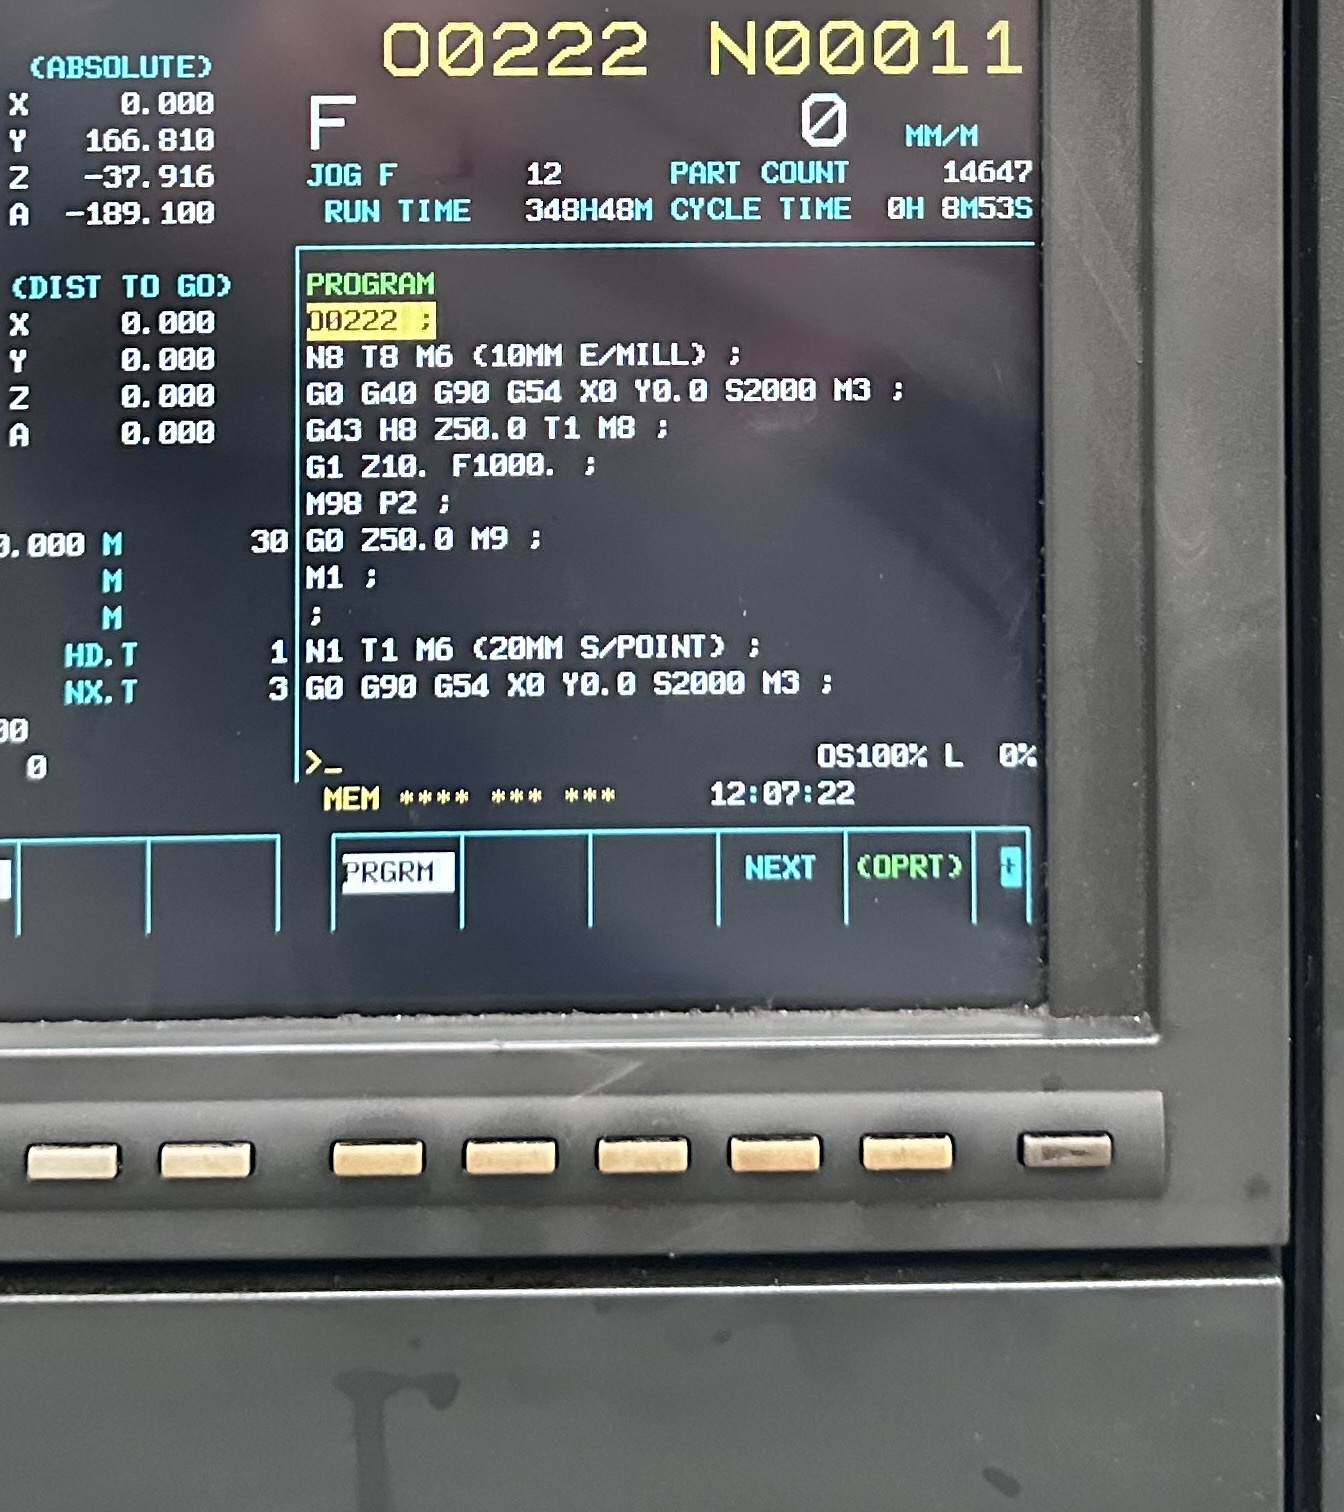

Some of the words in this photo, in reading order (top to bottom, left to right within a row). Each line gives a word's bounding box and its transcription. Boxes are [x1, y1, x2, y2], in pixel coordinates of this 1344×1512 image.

[710, 19, 1023, 76] N00011
[30, 54, 212, 80] (ABSOLUTE)
[8, 92, 29, 117] X
[121, 91, 215, 116] 0.000
[310, 95, 357, 151] F
[801, 92, 847, 148] 0
[905, 123, 979, 148] MM/M
[9, 129, 27, 153] Y
[86, 127, 215, 152] 166.810
[9, 165, 29, 190] Z
[83, 164, 215, 189] -37.916
[306, 163, 362, 187] JOG
[379, 162, 398, 187] F
[527, 161, 562, 186] 12
[670, 160, 741, 185] PART
[761, 160, 850, 184] COUNT
[943, 159, 1033, 183] 14647
[9, 202, 29, 227] A
[65, 200, 215, 226] -189.100
[324, 199, 380, 223] RUN
[397, 198, 472, 223] TIME
[525, 197, 653, 222] 348H48M
[670, 196, 762, 221] CYCLE
[779, 196, 852, 221] TIME
[887, 196, 925, 220] 0H
[941, 195, 1033, 220] 8M53S
[11, 274, 102, 300] (DIST
[121, 274, 160, 299] TO
[177, 273, 232, 298] GO)
[306, 271, 435, 296] PROGRAM
[306, 345, 344, 370] N8
[361, 344, 399, 369] T8
[416, 343, 454, 368] M6
[473, 343, 563, 368] (10MM
[579, 342, 706, 367] E/MILL)
[64, 641, 138, 668] HD.T
[473, 635, 564, 661] (20MM
[580, 633, 725, 660] S/POINT)
[64, 678, 138, 706] NX.T
[944, 742, 964, 768] L
[999, 742, 1038, 769] 0%
[323, 785, 380, 812] MEM
[710, 780, 856, 807] 12:07:22
[344, 863, 434, 883] PRGRM
[745, 854, 817, 881] NEXT
[857, 853, 963, 880] (OPRT)
